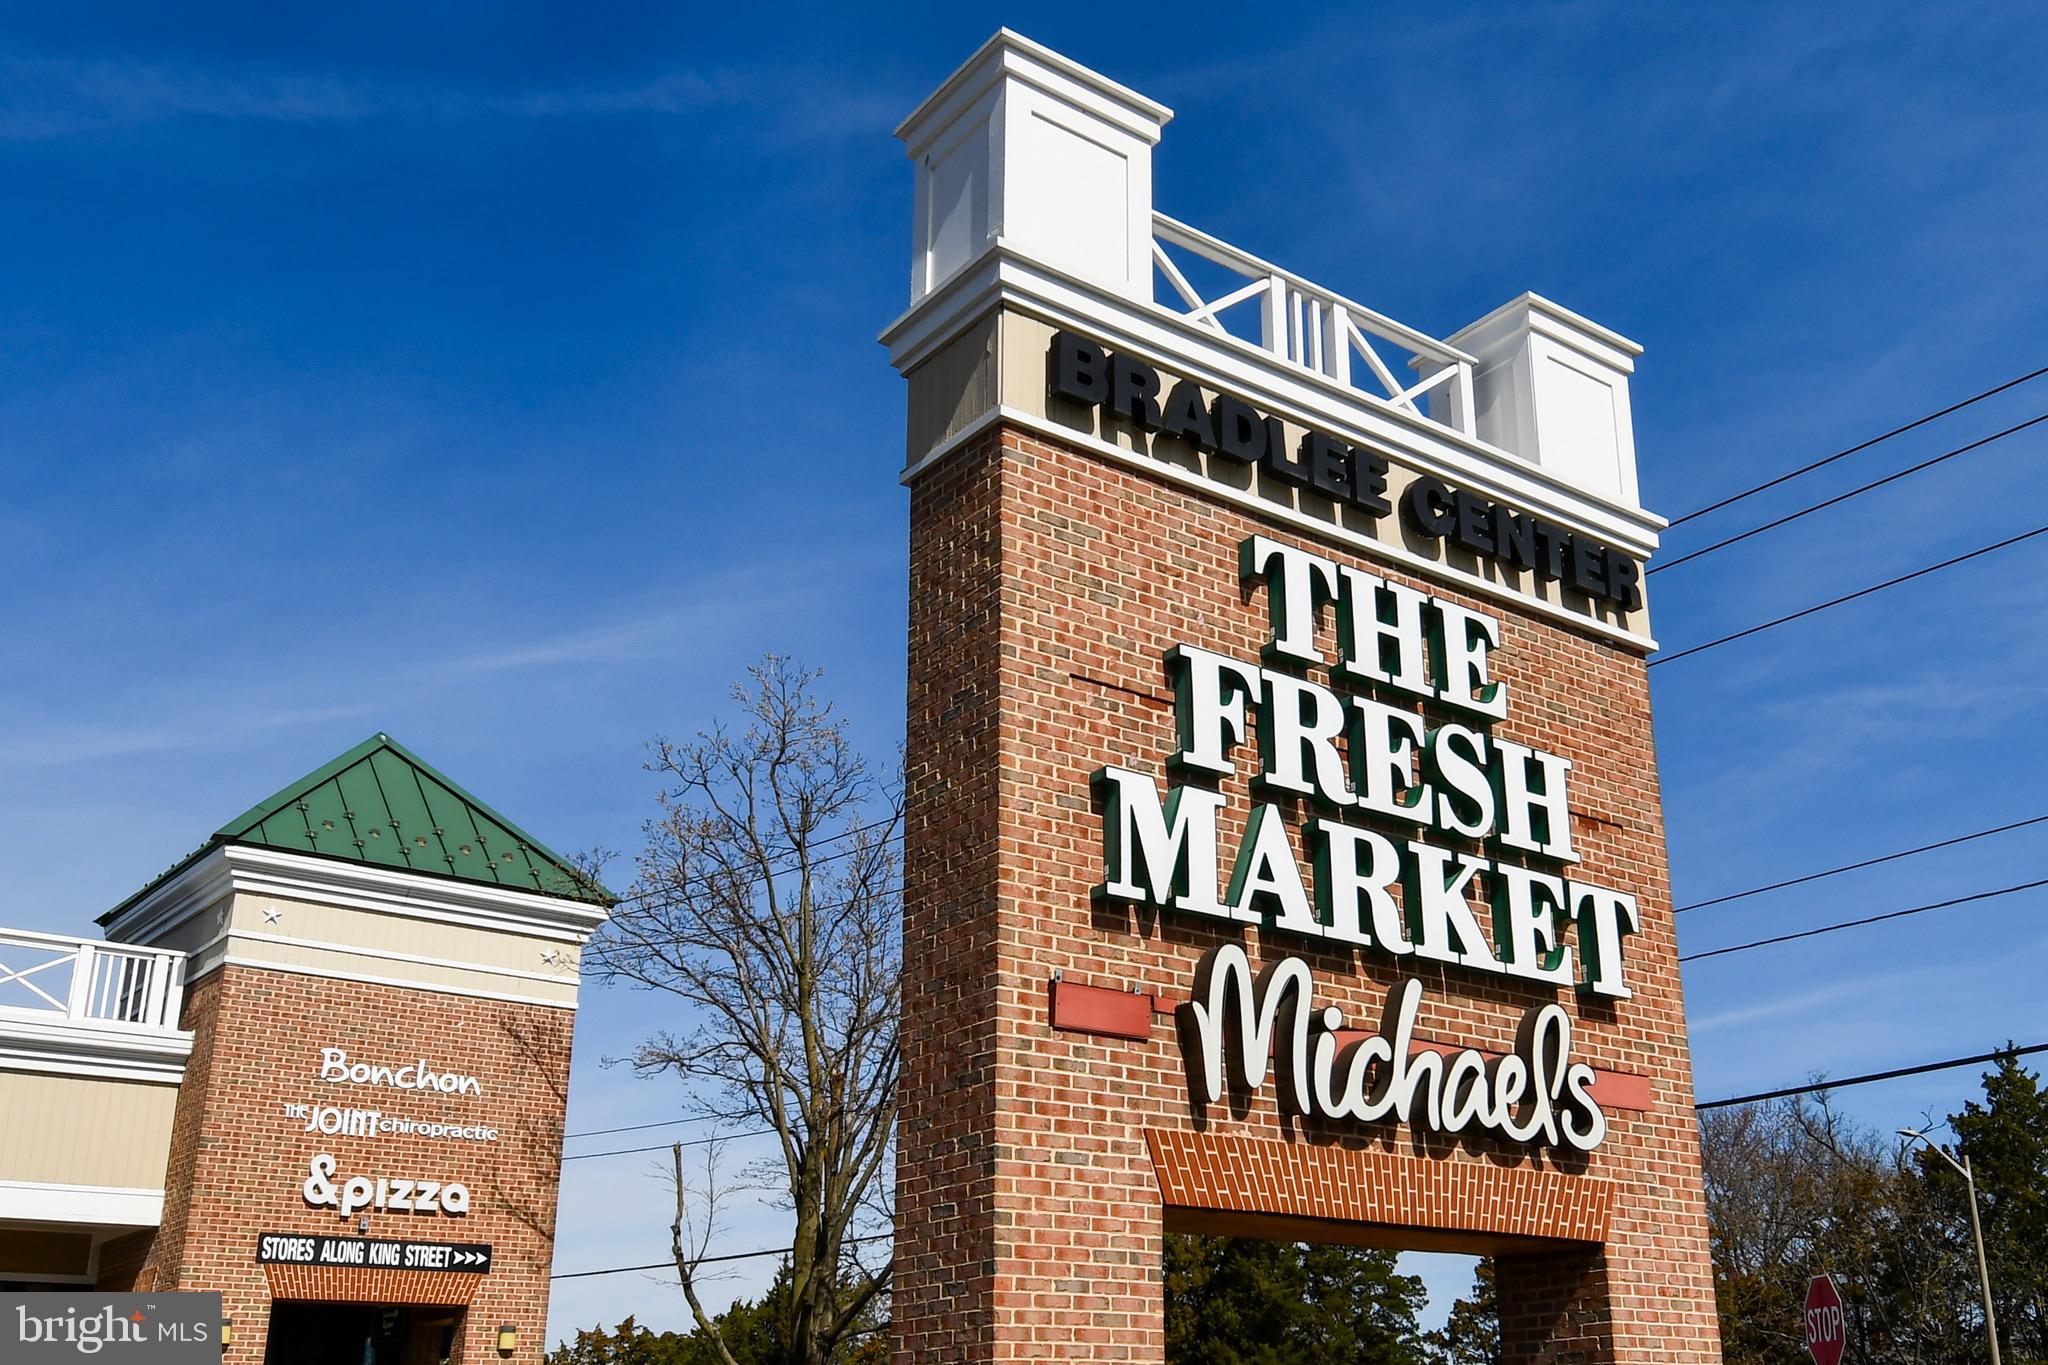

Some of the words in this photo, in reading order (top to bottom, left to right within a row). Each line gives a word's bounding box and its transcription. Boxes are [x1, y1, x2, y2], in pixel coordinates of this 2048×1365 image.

[1049, 329, 1392, 518] BRADLEE
[1405, 476, 1642, 612] CENTER
[1241, 534, 1507, 721] THE
[1168, 644, 1581, 864] FRESH
[1094, 766, 1640, 999] MARKET
[320, 1048, 481, 1096] Bonchon
[284, 1103, 308, 1120] THE
[305, 1106, 382, 1137] JOINT
[379, 1117, 499, 1141] chiropractic
[303, 1153, 470, 1217] &pizza
[261, 1236, 315, 1262] STORES
[319, 1240, 365, 1264] ALONG
[368, 1242, 401, 1266] KING
[404, 1244, 453, 1268] STREET
[1807, 1305, 1840, 1343] STOP
